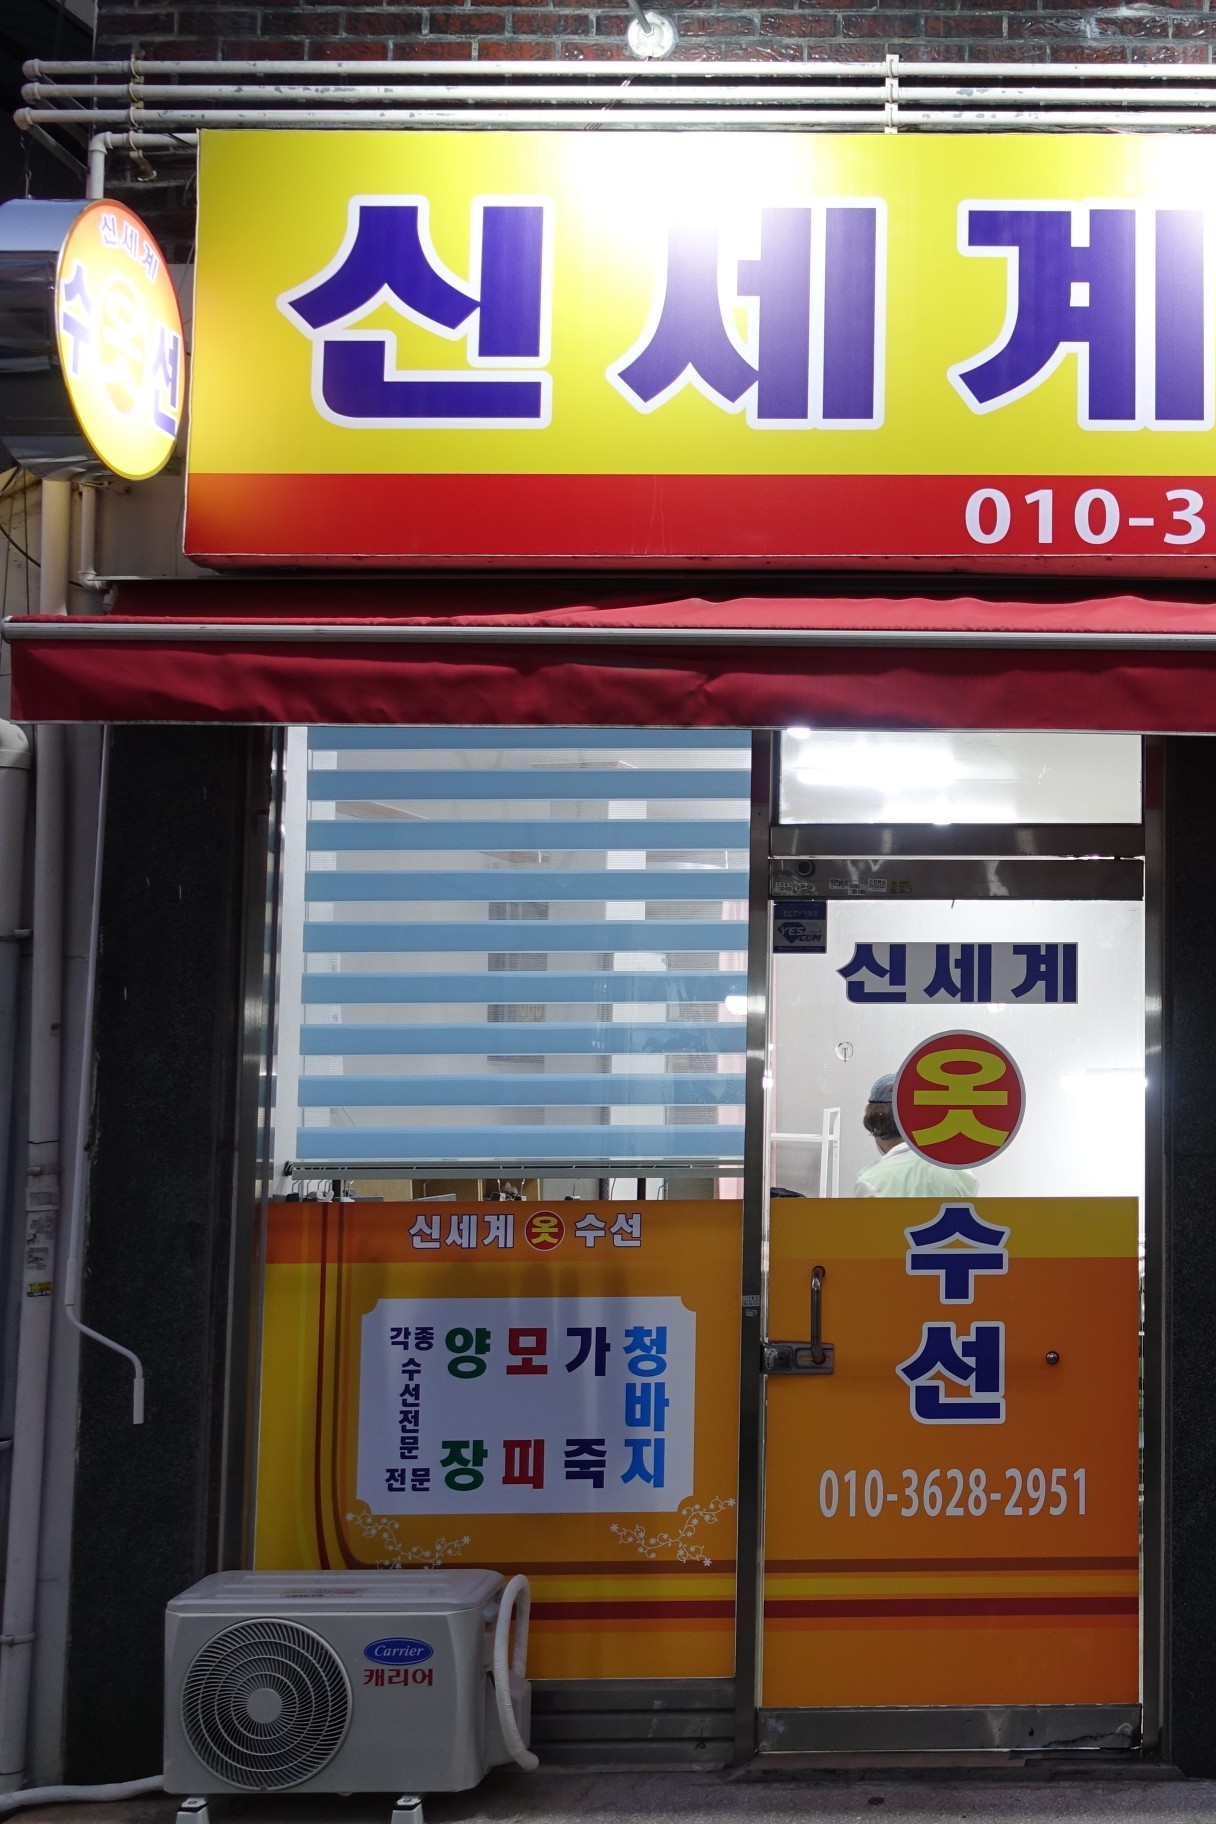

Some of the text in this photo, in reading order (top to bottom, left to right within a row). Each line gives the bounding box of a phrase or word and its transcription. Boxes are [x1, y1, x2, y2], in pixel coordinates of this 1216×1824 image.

[100, 212, 160, 284] 신세계
[277, 194, 1215, 431] 신세계
[779, 926, 806, 936] YES
[836, 941, 1079, 1004] 신세계
[911, 1047, 1010, 1147] 옷
[408, 1213, 643, 1249] 신세계 옷 수선
[389, 1326, 435, 1352] 각종
[896, 1202, 1012, 1425] 수선
[398, 1356, 422, 1461] 수선전문
[620, 1325, 670, 1489] 청바지
[385, 1467, 431, 1493] 전문
[818, 1467, 1088, 1519] 010-3628-2951
[363, 1667, 434, 1688] 캐리어
[374, 1643, 425, 1658] Carrier
